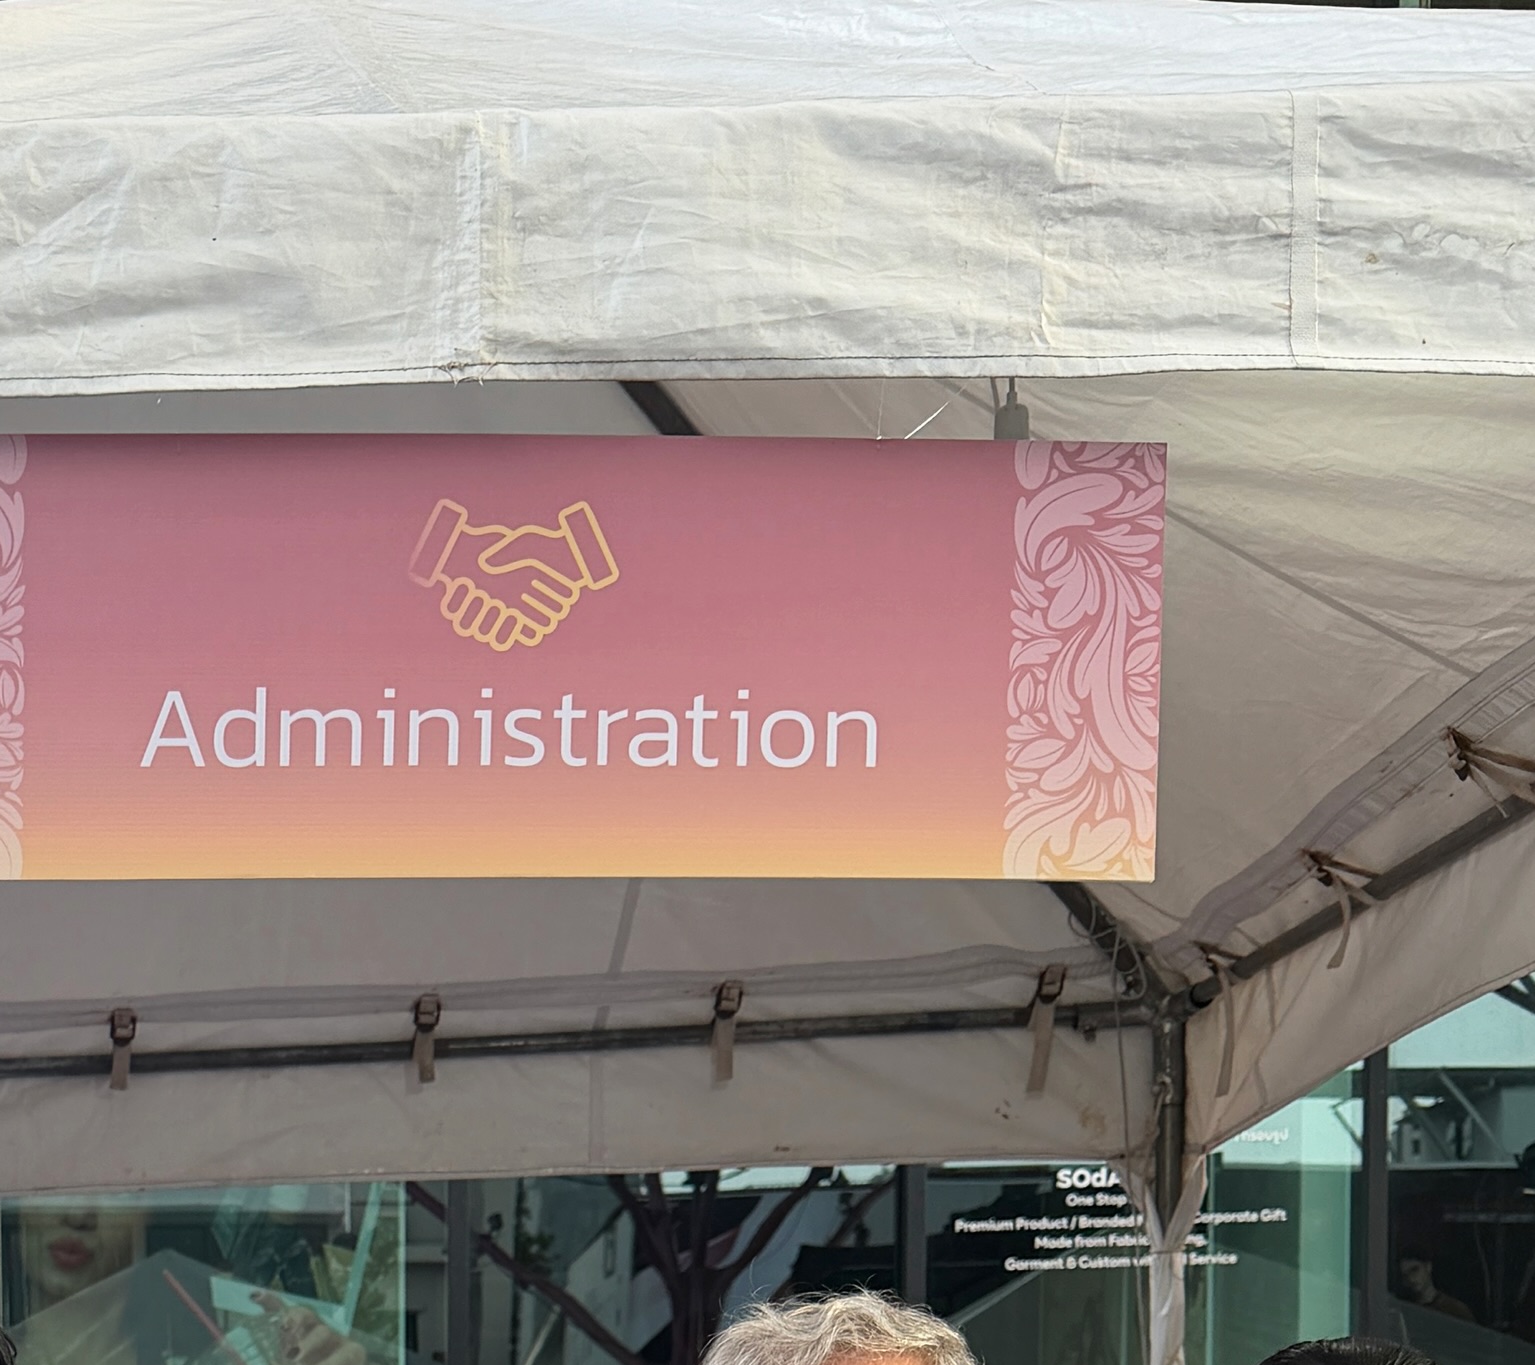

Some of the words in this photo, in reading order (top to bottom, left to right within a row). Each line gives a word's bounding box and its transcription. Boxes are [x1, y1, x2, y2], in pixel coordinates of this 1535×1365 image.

[141, 687, 881, 768] Administration
[1065, 1193, 1094, 1208] One
[1096, 1192, 1127, 1208] Stop
[954, 1217, 1014, 1233] Premium
[1016, 1216, 1068, 1231] Product
[1079, 1213, 1135, 1229] Branded
[1260, 1208, 1288, 1223] Gift
[1034, 1235, 1073, 1250] Made
[1074, 1234, 1107, 1248] from
[1004, 1256, 1064, 1271] Garment
[1078, 1254, 1131, 1270] Custom
[1189, 1251, 1238, 1267] Service
